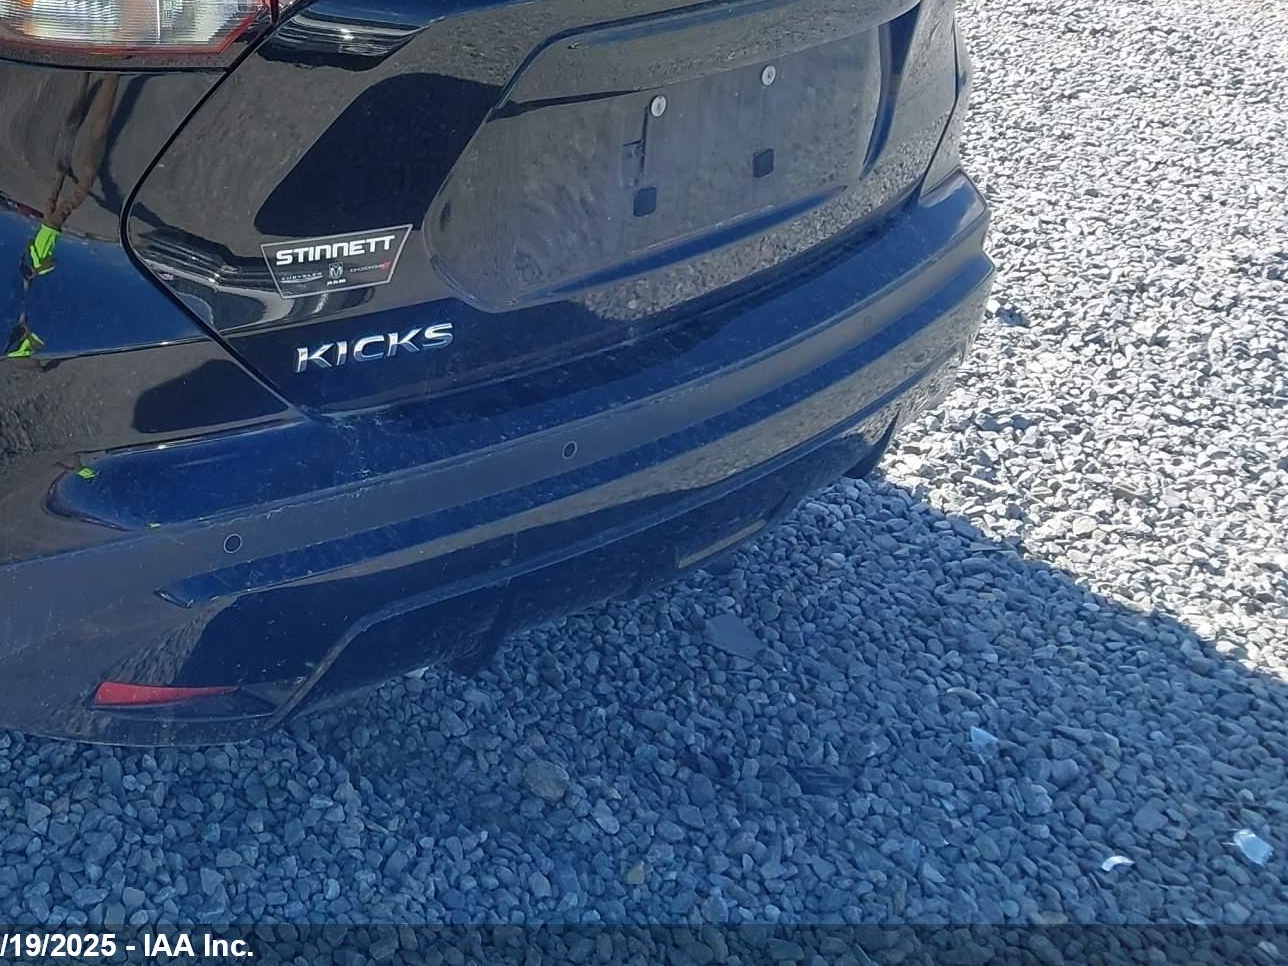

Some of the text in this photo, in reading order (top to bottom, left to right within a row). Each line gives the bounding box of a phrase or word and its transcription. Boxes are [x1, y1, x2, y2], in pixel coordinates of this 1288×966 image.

[275, 234, 396, 266] STINNETT
[327, 278, 347, 287] RAM
[295, 322, 454, 373] KICKS
